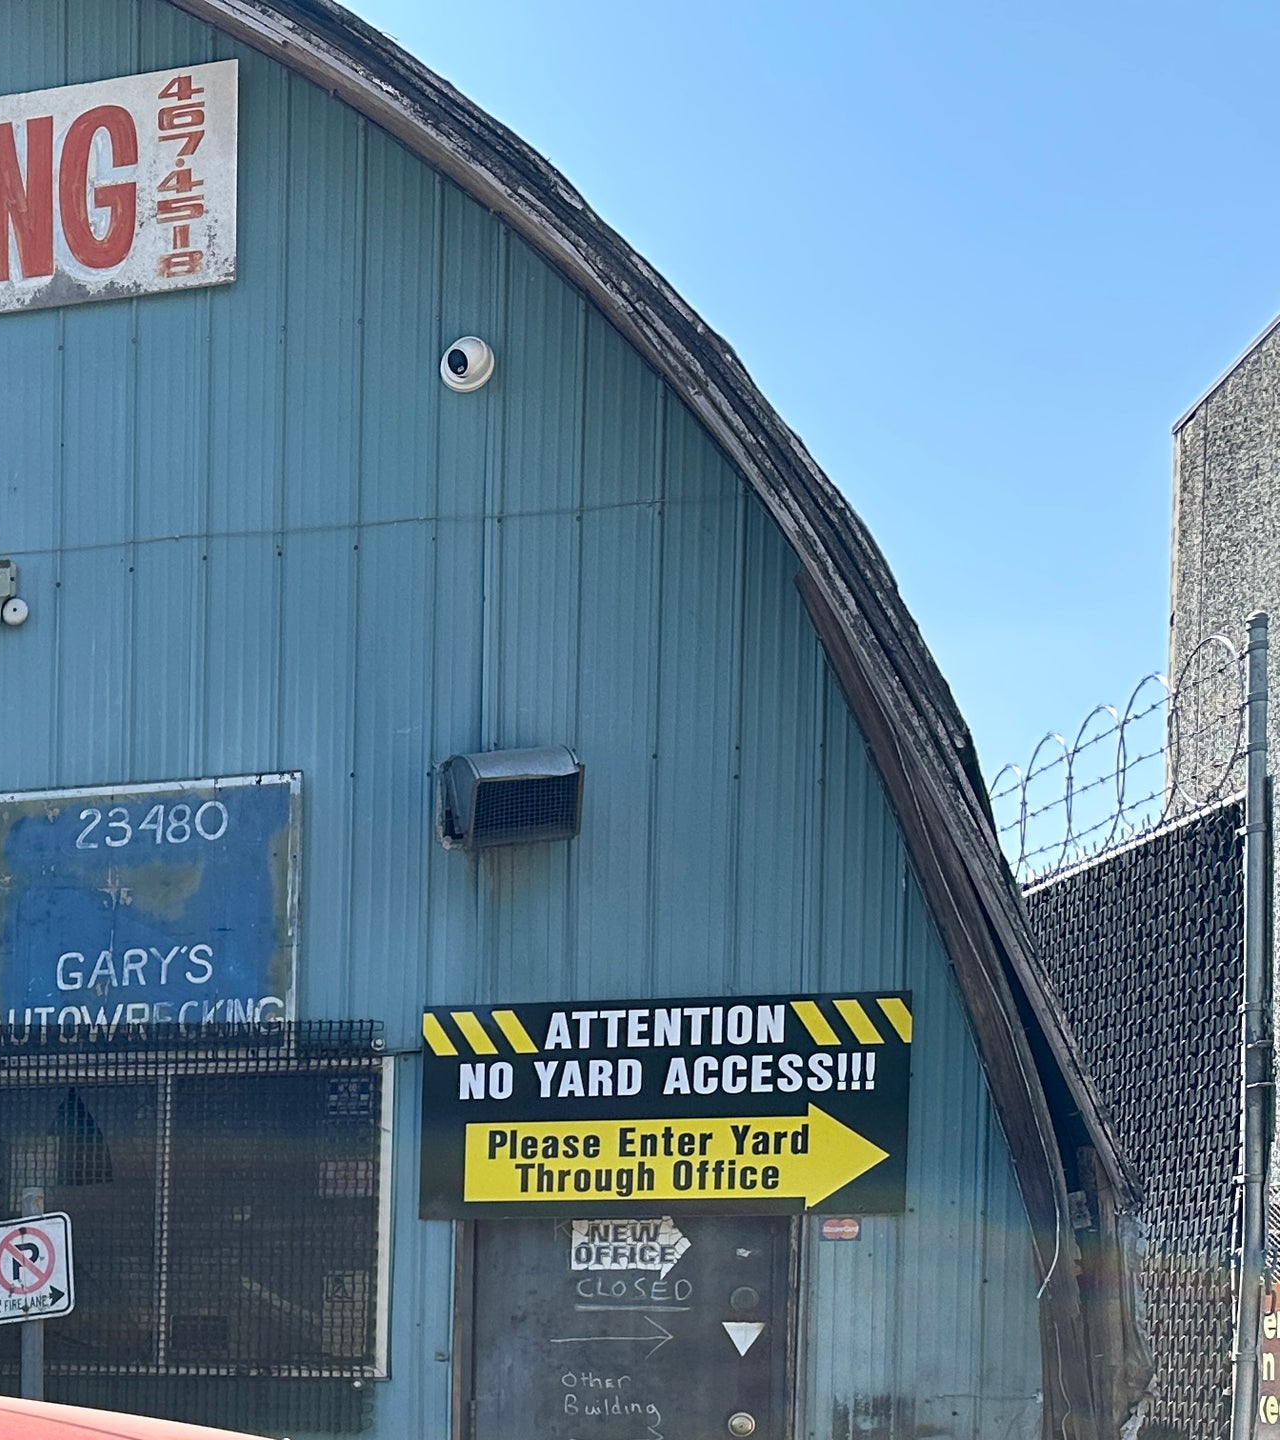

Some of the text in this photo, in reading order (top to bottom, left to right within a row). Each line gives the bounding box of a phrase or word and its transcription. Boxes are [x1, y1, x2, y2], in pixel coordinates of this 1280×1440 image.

[76, 801, 228, 849] 23480
[57, 944, 213, 990] GARY'S
[544, 1005, 785, 1050] ATTENTION
[459, 1052, 877, 1100] NO YARD ACCESS!!!
[488, 1124, 809, 1160] Please Enter Yard
[515, 1160, 779, 1197] Through Office
[590, 1223, 659, 1242] NEW
[575, 1242, 677, 1265] OFFICE
[4, 1295, 49, 1312] FIRE LANE
[576, 1277, 692, 1301] CLOSED
[564, 1394, 662, 1428] Building
